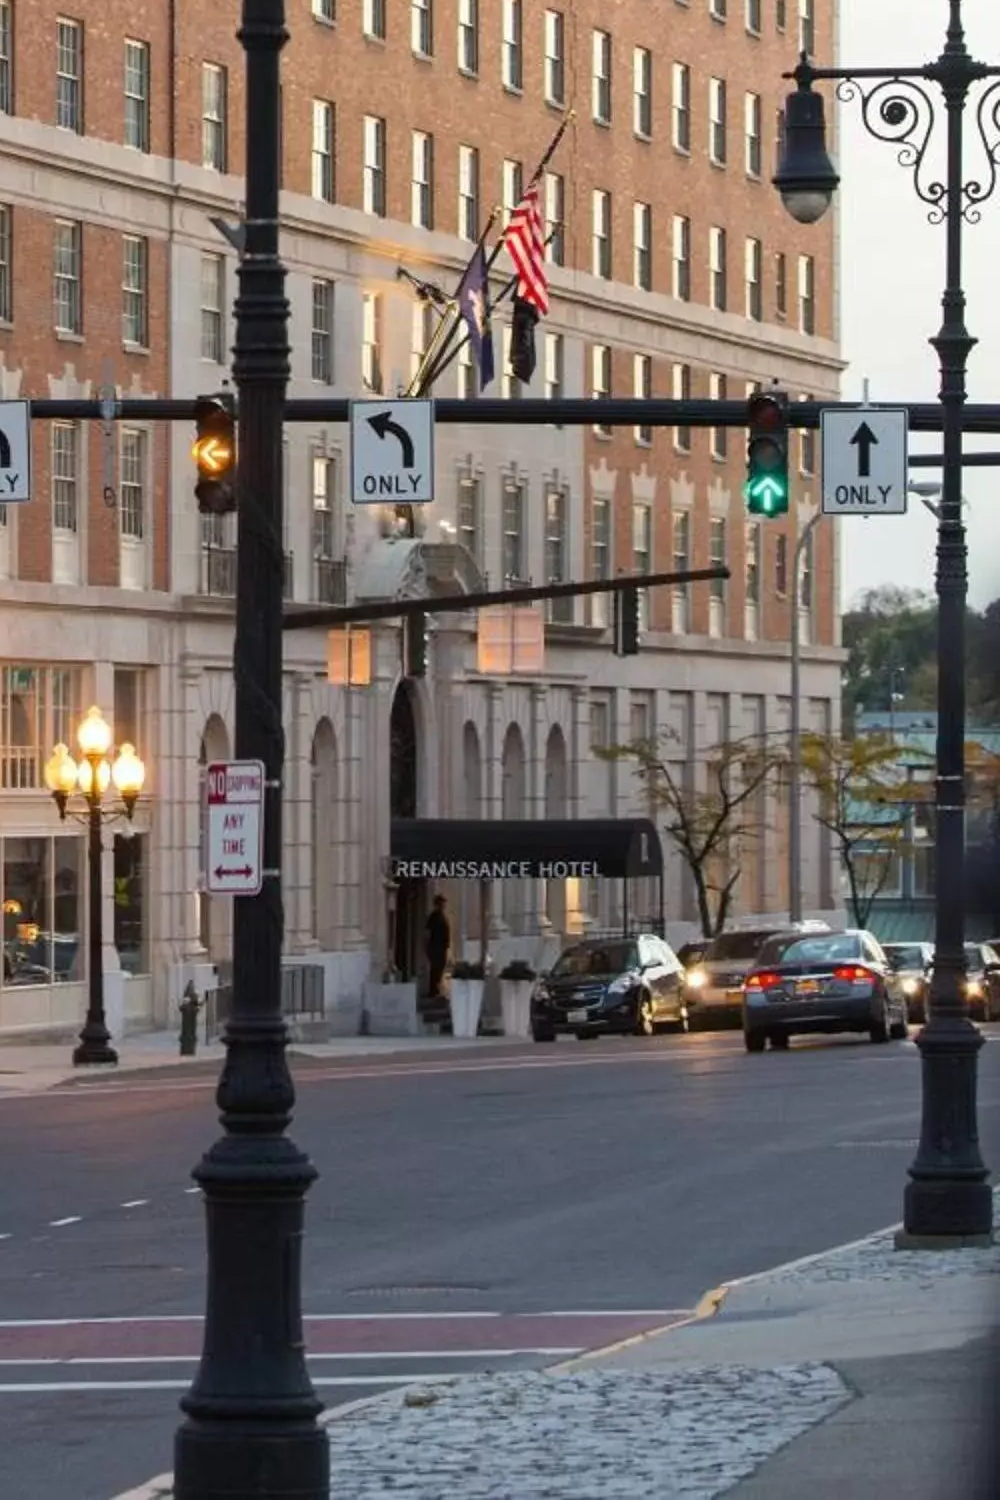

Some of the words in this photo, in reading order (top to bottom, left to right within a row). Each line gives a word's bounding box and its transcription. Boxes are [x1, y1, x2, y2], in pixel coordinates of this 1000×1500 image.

[363, 474, 422, 496] ONLY
[835, 484, 893, 505] ONLY
[209, 771, 225, 796] NO
[223, 813, 245, 830] ANY
[222, 838, 246, 856] TIME
[397, 861, 532, 879] RENAISSANCE
[539, 861, 601, 879] HOTEL
